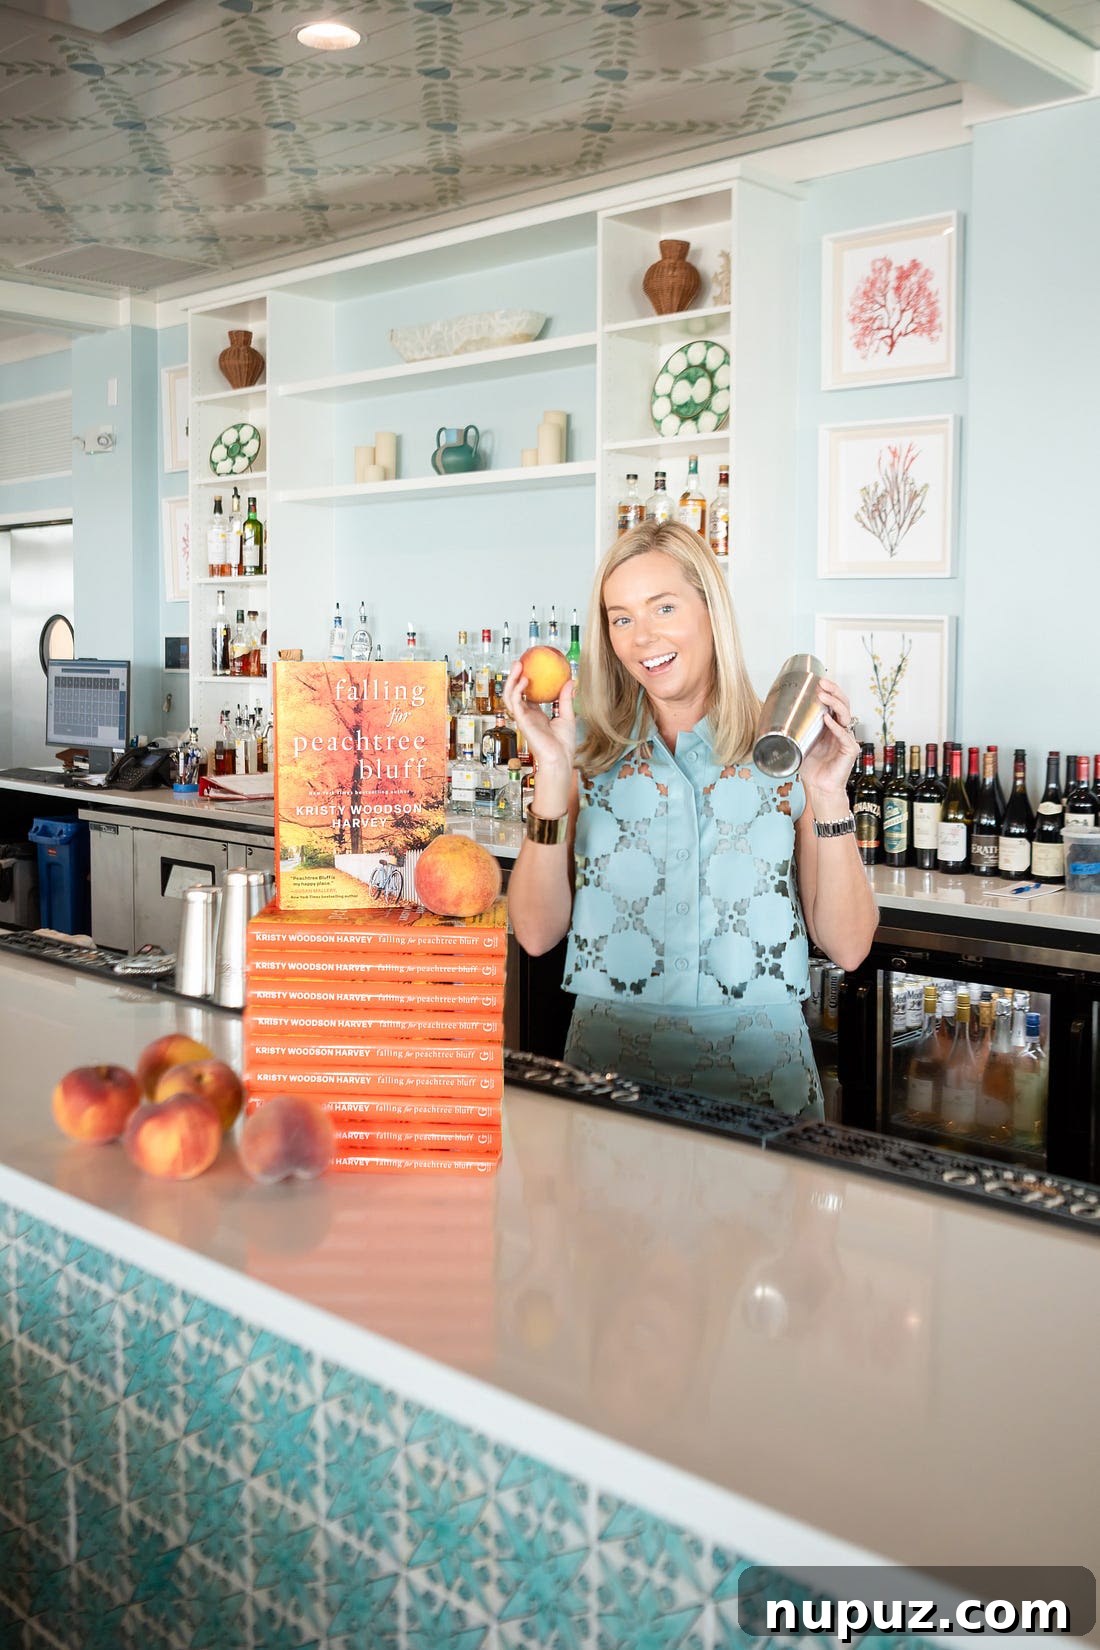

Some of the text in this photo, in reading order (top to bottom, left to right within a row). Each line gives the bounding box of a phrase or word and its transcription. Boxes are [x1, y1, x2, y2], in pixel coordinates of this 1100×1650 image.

[335, 678, 426, 707] falling
[386, 708, 412, 727] for
[293, 730, 426, 758] peachtree
[359, 757, 427, 781] bluff
[296, 804, 423, 816] KRISTY WOODSON
[332, 818, 387, 829] HARVEY
[256, 933, 287, 941] KRISTY
[288, 934, 335, 942] WOODSON
[337, 936, 372, 944] HARVEY
[378, 936, 406, 945] falling
[418, 936, 457, 946] peachtree
[460, 936, 480, 944] bluff
[256, 961, 286, 969] KRISTY
[288, 962, 334, 971] WOODSON
[336, 964, 370, 972] HARVEY
[378, 964, 405, 973] falling
[416, 965, 455, 973] peachtree
[458, 965, 478, 973] bluff
[289, 992, 334, 1000] WOODSON
[336, 993, 372, 1001] HARVEY
[378, 994, 404, 1003] falling
[416, 995, 455, 1004] peachtree
[458, 996, 478, 1004] bluff
[258, 1018, 289, 1026] KRISTY
[290, 1019, 336, 1027] WOODSON
[338, 1020, 373, 1028] HARVEY
[379, 1021, 406, 1029] falling
[418, 1021, 457, 1030] peachtree
[459, 1021, 478, 1030] bluff
[288, 1048, 334, 1056] WOODSON
[376, 1049, 403, 1059] falling
[415, 1050, 454, 1059] peachtree
[456, 1050, 475, 1058] bluff
[289, 1075, 335, 1083] WOODSON
[336, 1076, 371, 1084] HARVEY
[377, 1075, 404, 1086] falling
[416, 1077, 454, 1086] peachtree
[457, 1078, 476, 1086] bluff
[335, 1104, 370, 1112] HARVEY
[376, 1104, 402, 1113] falling
[414, 1105, 452, 1114] peachtree
[454, 1105, 474, 1114] bluff
[376, 1131, 402, 1141] falling
[415, 1133, 452, 1142] peachtree
[454, 1133, 474, 1141] bluff
[336, 1158, 369, 1166] HARVEY
[376, 1159, 402, 1168] falling
[414, 1160, 452, 1169] peachtree
[454, 1161, 473, 1169] bluff
